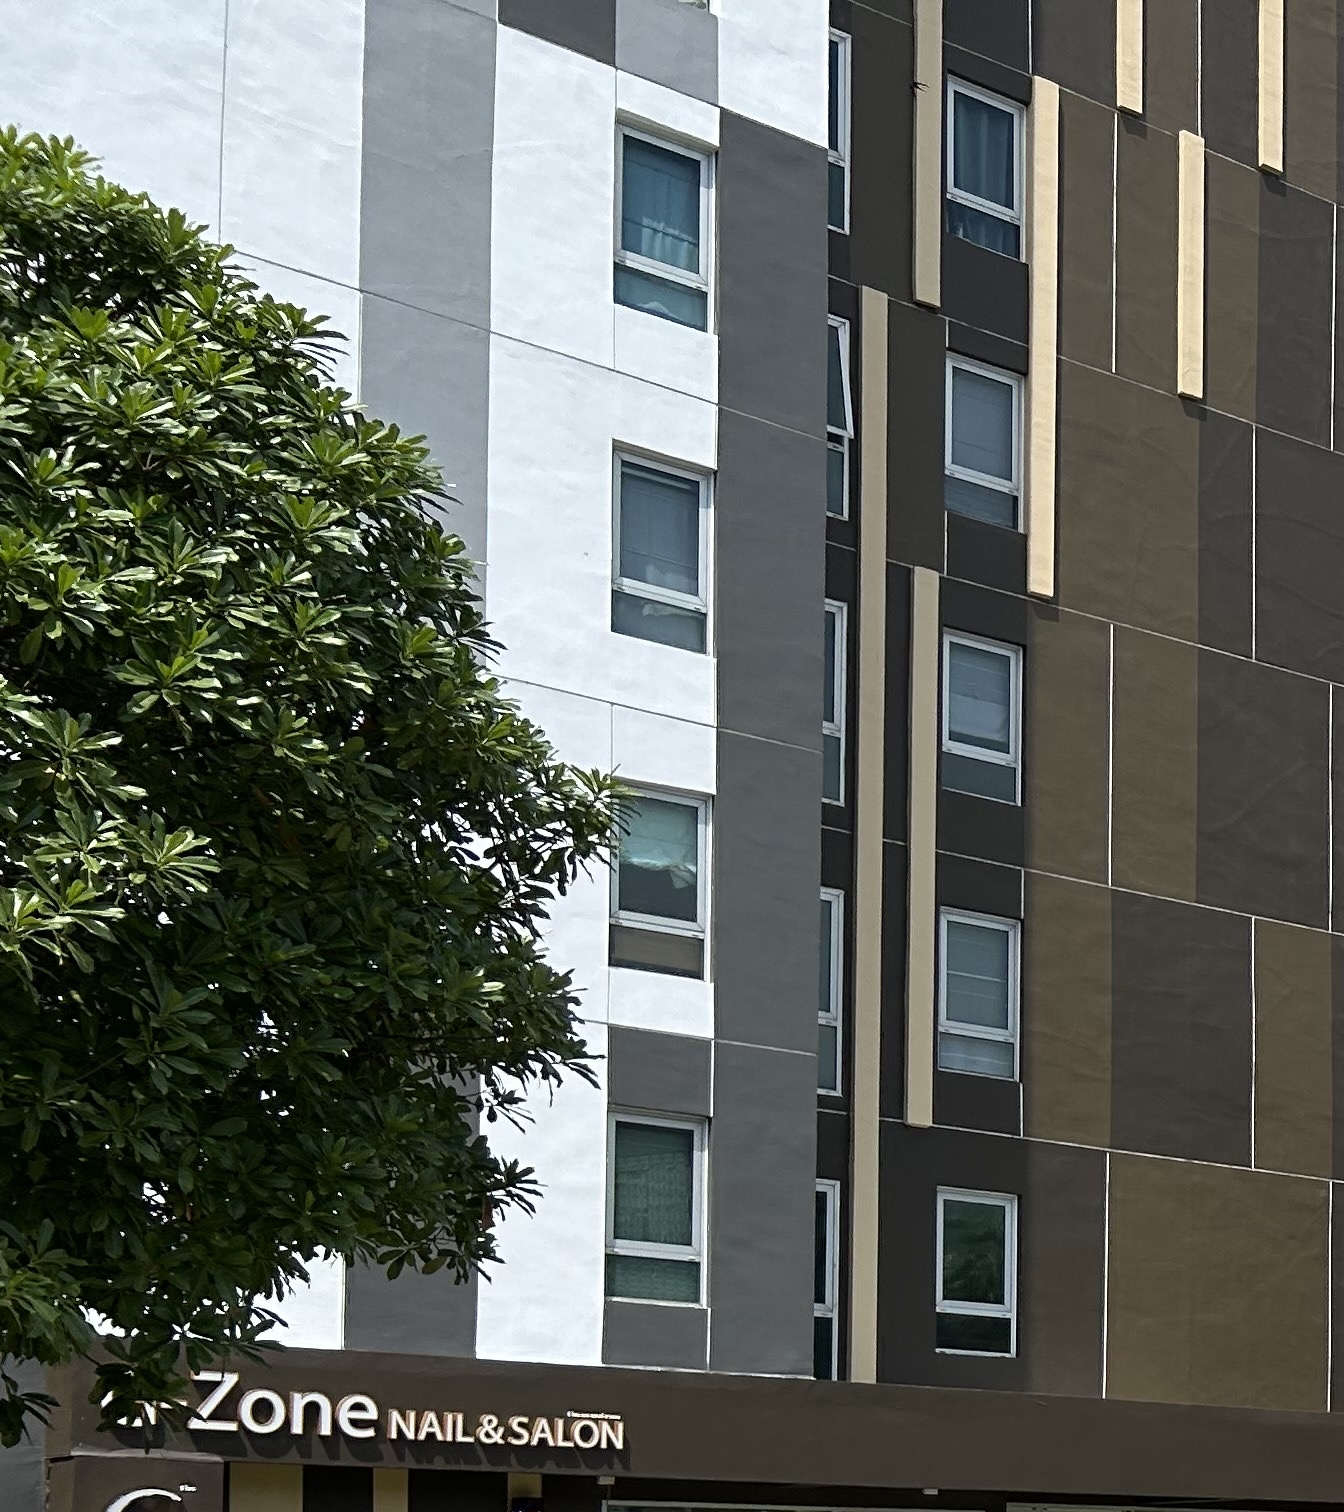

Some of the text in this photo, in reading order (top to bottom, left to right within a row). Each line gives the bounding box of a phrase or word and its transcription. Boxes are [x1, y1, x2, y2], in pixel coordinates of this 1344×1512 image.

[387, 1408, 474, 1443] NAIL
[475, 1413, 505, 1445] &
[507, 1416, 624, 1450] SALON
